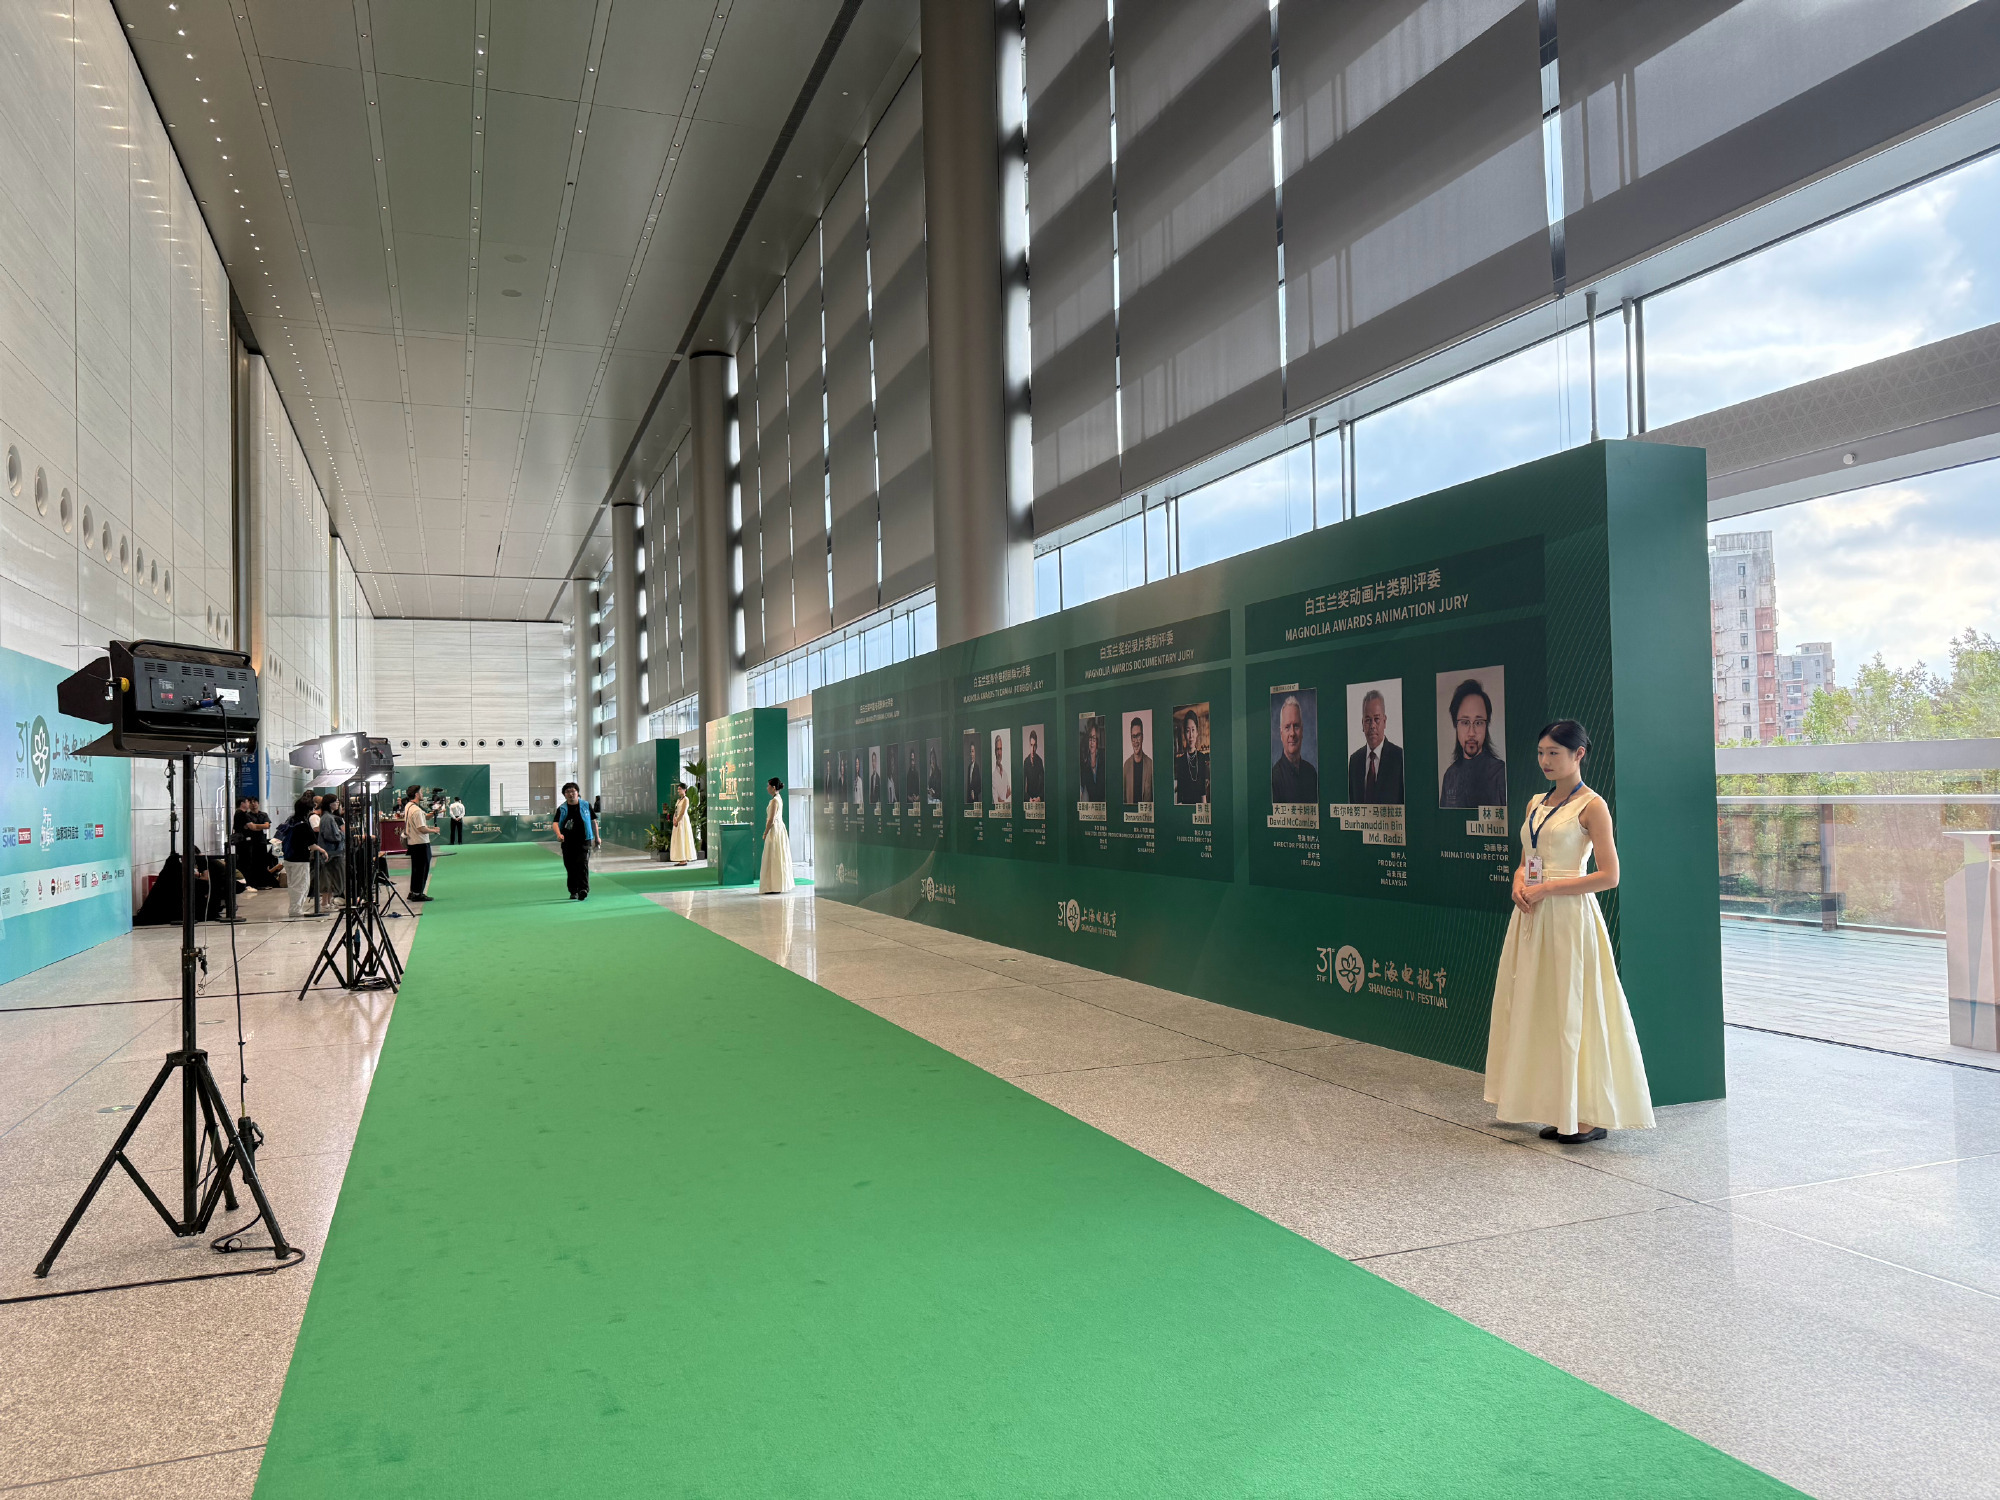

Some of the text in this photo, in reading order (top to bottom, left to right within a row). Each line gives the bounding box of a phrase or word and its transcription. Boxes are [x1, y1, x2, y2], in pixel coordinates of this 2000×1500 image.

[1305, 568, 1441, 617] 白玉兰奖动画片类别评委
[1285, 594, 1469, 642] MAGNOLIA AWARDS ANIMATION JURY
[1100, 629, 1174, 660] 白玉兰奖纪录片类别评委
[1085, 648, 1194, 680] MAGNOLIA AWARDS DOCUMENTARY JURY
[52, 767, 73, 781] SHANGHAI
[79, 770, 94, 783] FESTIVAL
[1269, 817, 1286, 826] David
[1344, 820, 1403, 831] Burhanuddin Bin
[84, 829, 94, 841] SMG
[1470, 823, 1505, 835] LIN Hun
[2, 834, 17, 848] SMG
[1368, 833, 1403, 844] Md. Radzi
[1273, 841, 1320, 850] DIRECTOR PRODUCER
[1440, 850, 1509, 861] ANIMATION DIRECTOR
[1301, 859, 1321, 867] IRELAND
[1377, 859, 1407, 868] PRODUCER
[1380, 878, 1408, 887] MALAYSIA
[1488, 874, 1510, 882] CHINA
[1368, 958, 1447, 995] 上海电视节
[1367, 982, 1449, 1009] SHANGHAI TV FESTIVAL
